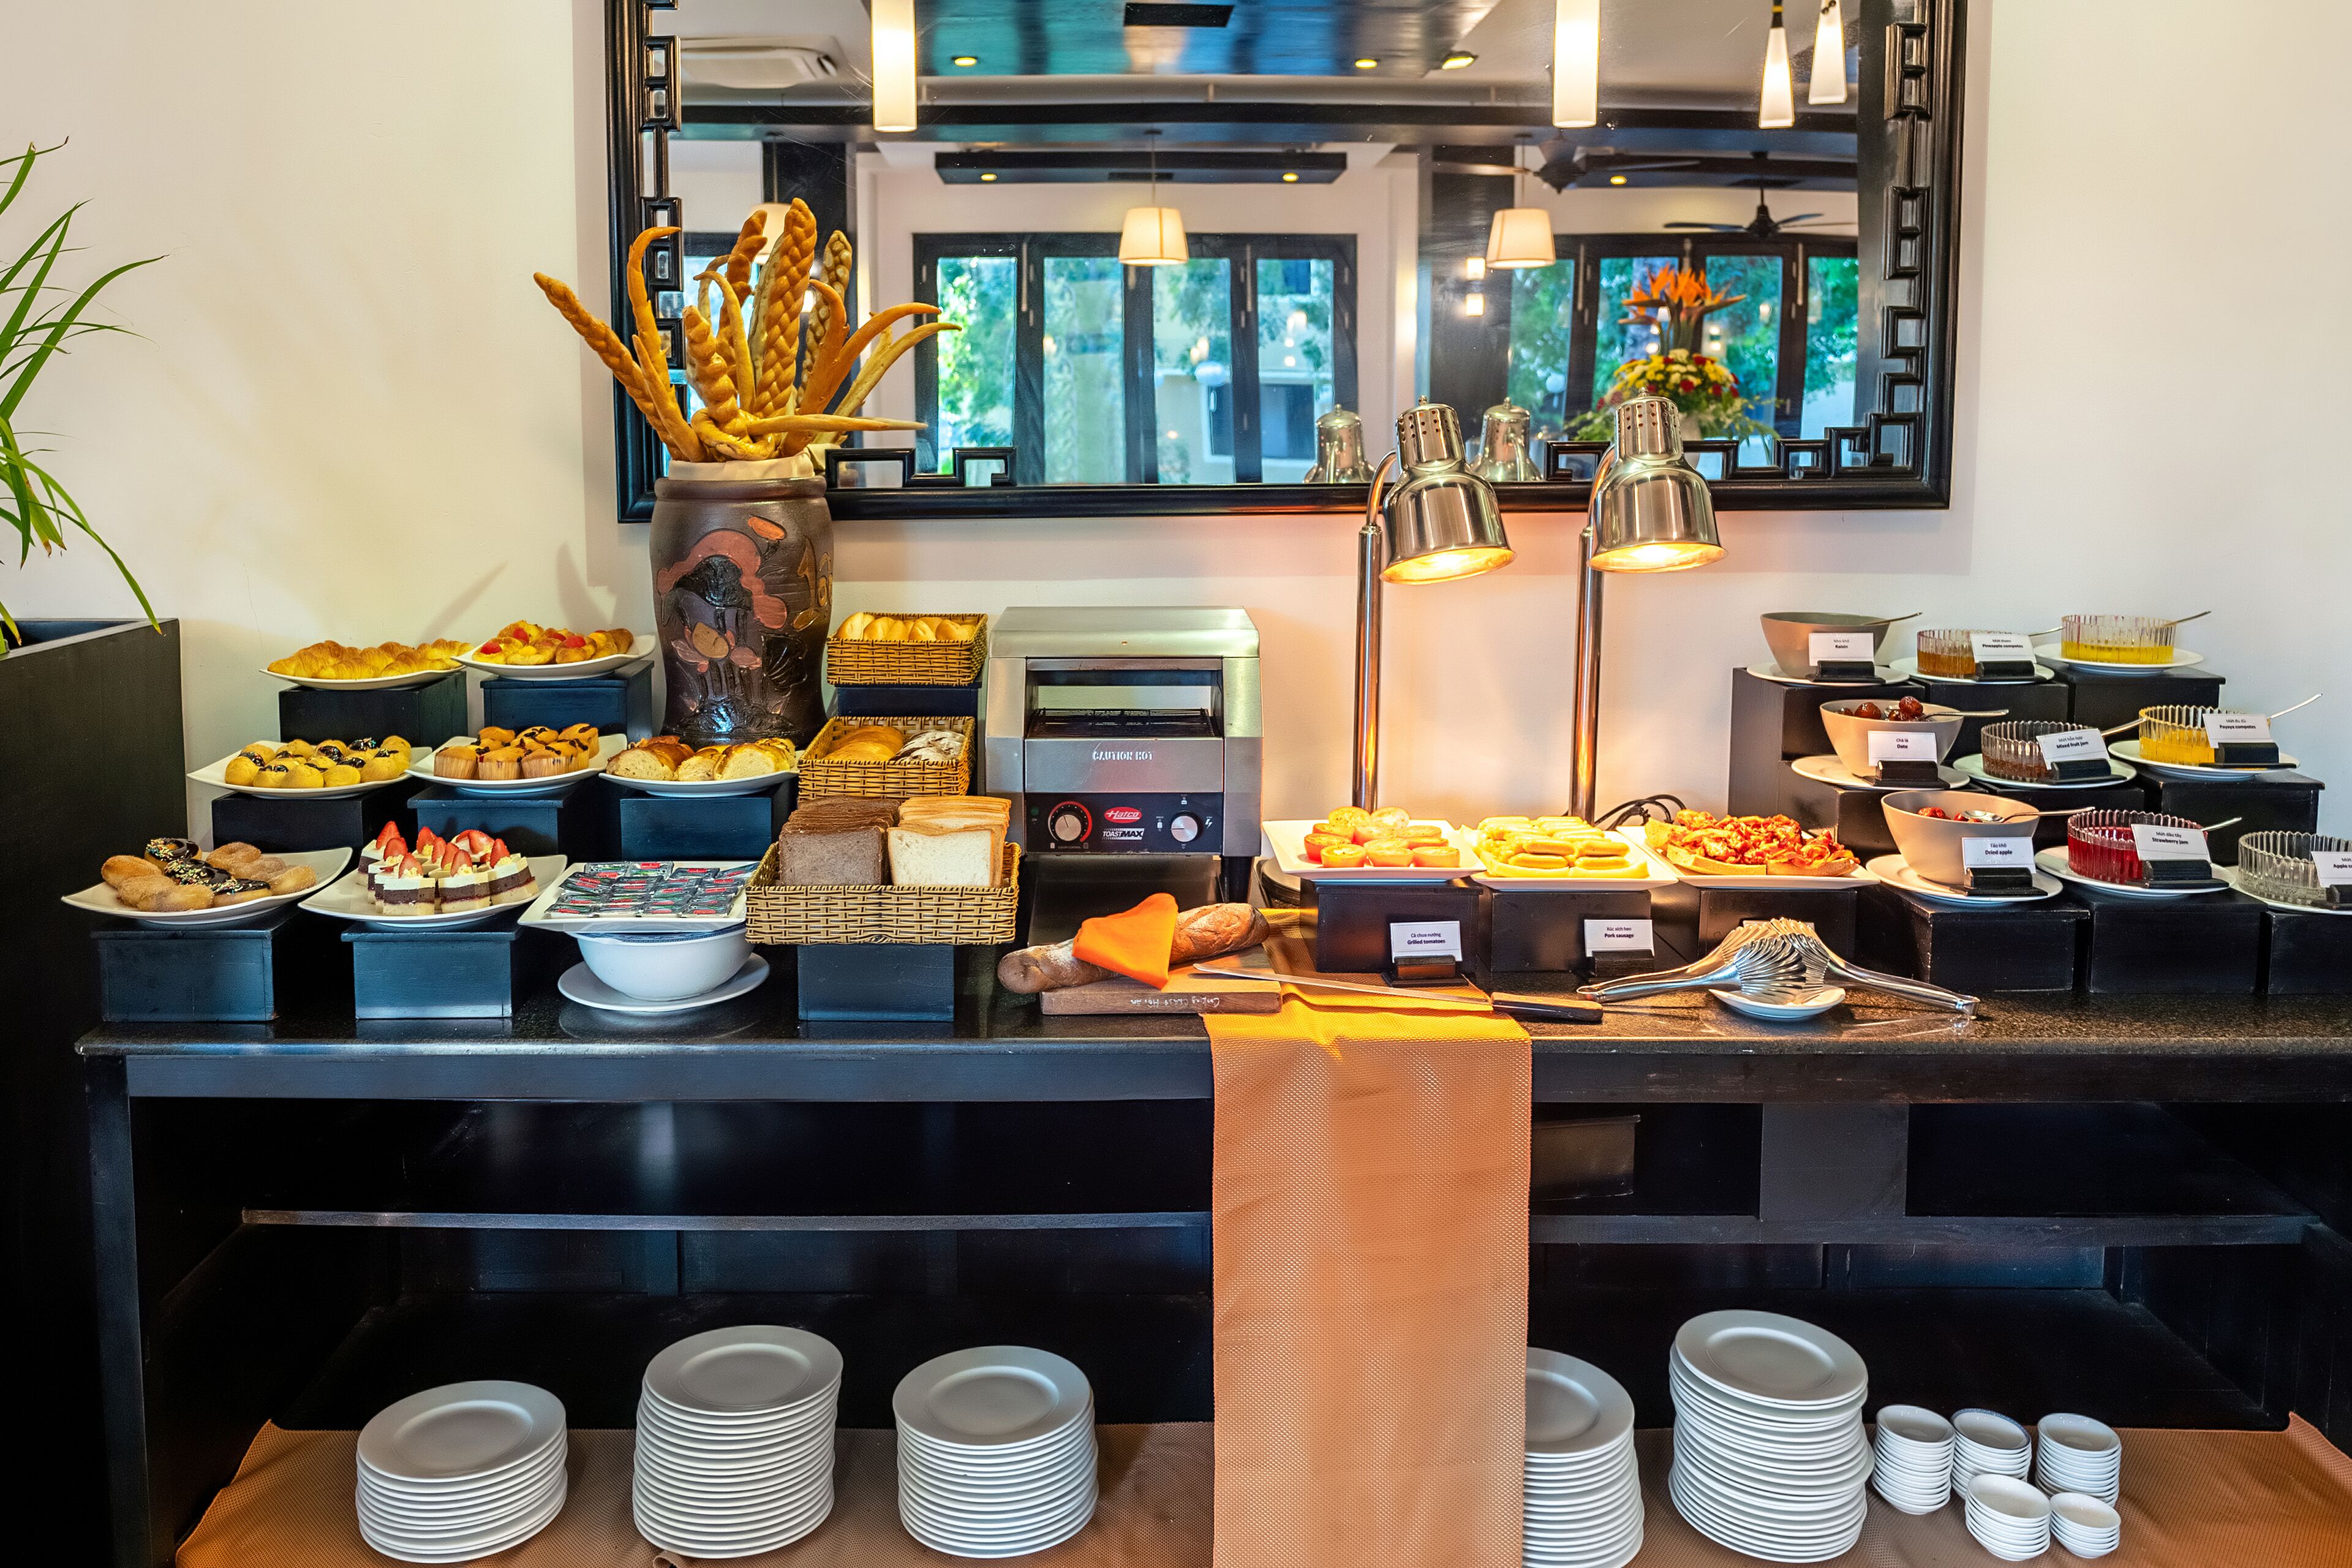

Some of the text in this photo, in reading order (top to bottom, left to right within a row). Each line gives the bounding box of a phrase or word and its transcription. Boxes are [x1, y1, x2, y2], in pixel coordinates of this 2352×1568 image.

[1092, 751, 1153, 761] CAUTION HOT
[1106, 810, 1140, 820] Hatco
